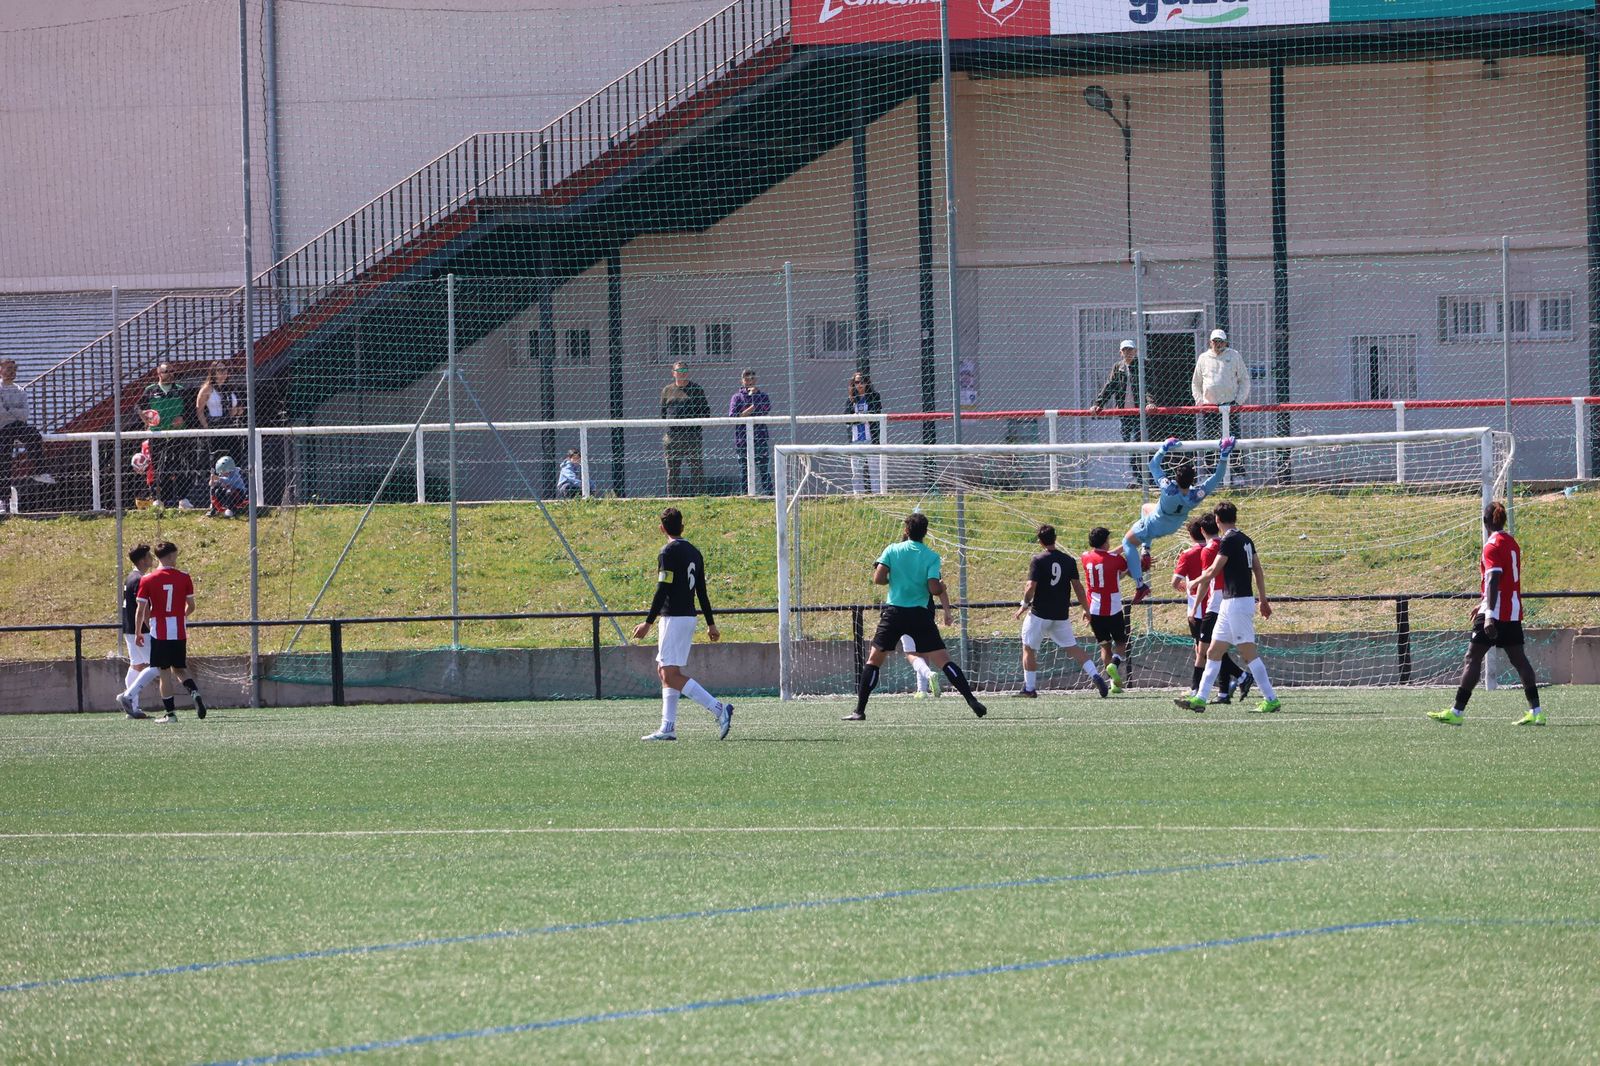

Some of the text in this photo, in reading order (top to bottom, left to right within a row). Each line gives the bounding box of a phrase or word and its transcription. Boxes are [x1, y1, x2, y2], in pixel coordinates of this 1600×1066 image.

[687, 562, 696, 590] 6
[1050, 562, 1062, 587] 9
[1086, 562, 1105, 588] 11
[163, 584, 174, 612] 7
